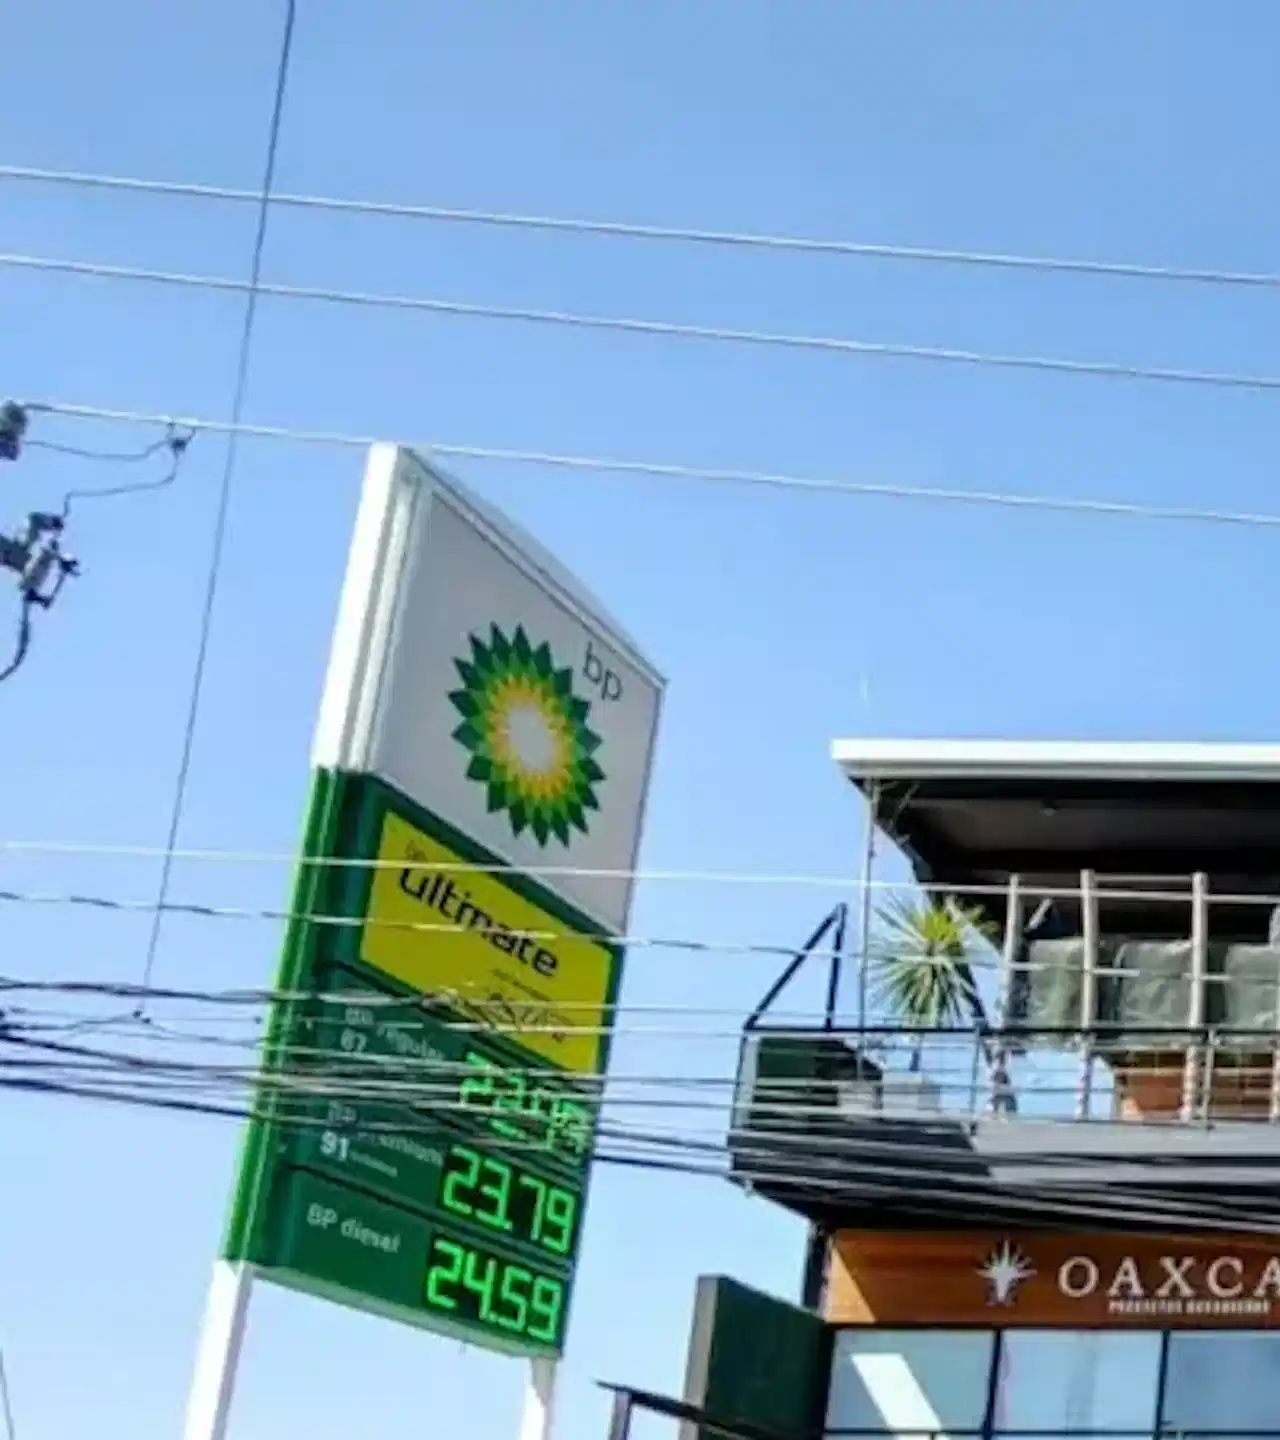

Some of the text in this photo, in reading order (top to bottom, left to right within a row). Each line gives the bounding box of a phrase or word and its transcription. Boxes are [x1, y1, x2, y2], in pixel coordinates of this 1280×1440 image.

[583, 641, 624, 701] bp
[400, 866, 558, 977] ultimate
[307, 1202, 401, 1253] BP diesel
[442, 1145, 577, 1255] 23.79
[426, 1238, 562, 1342] 24.59
